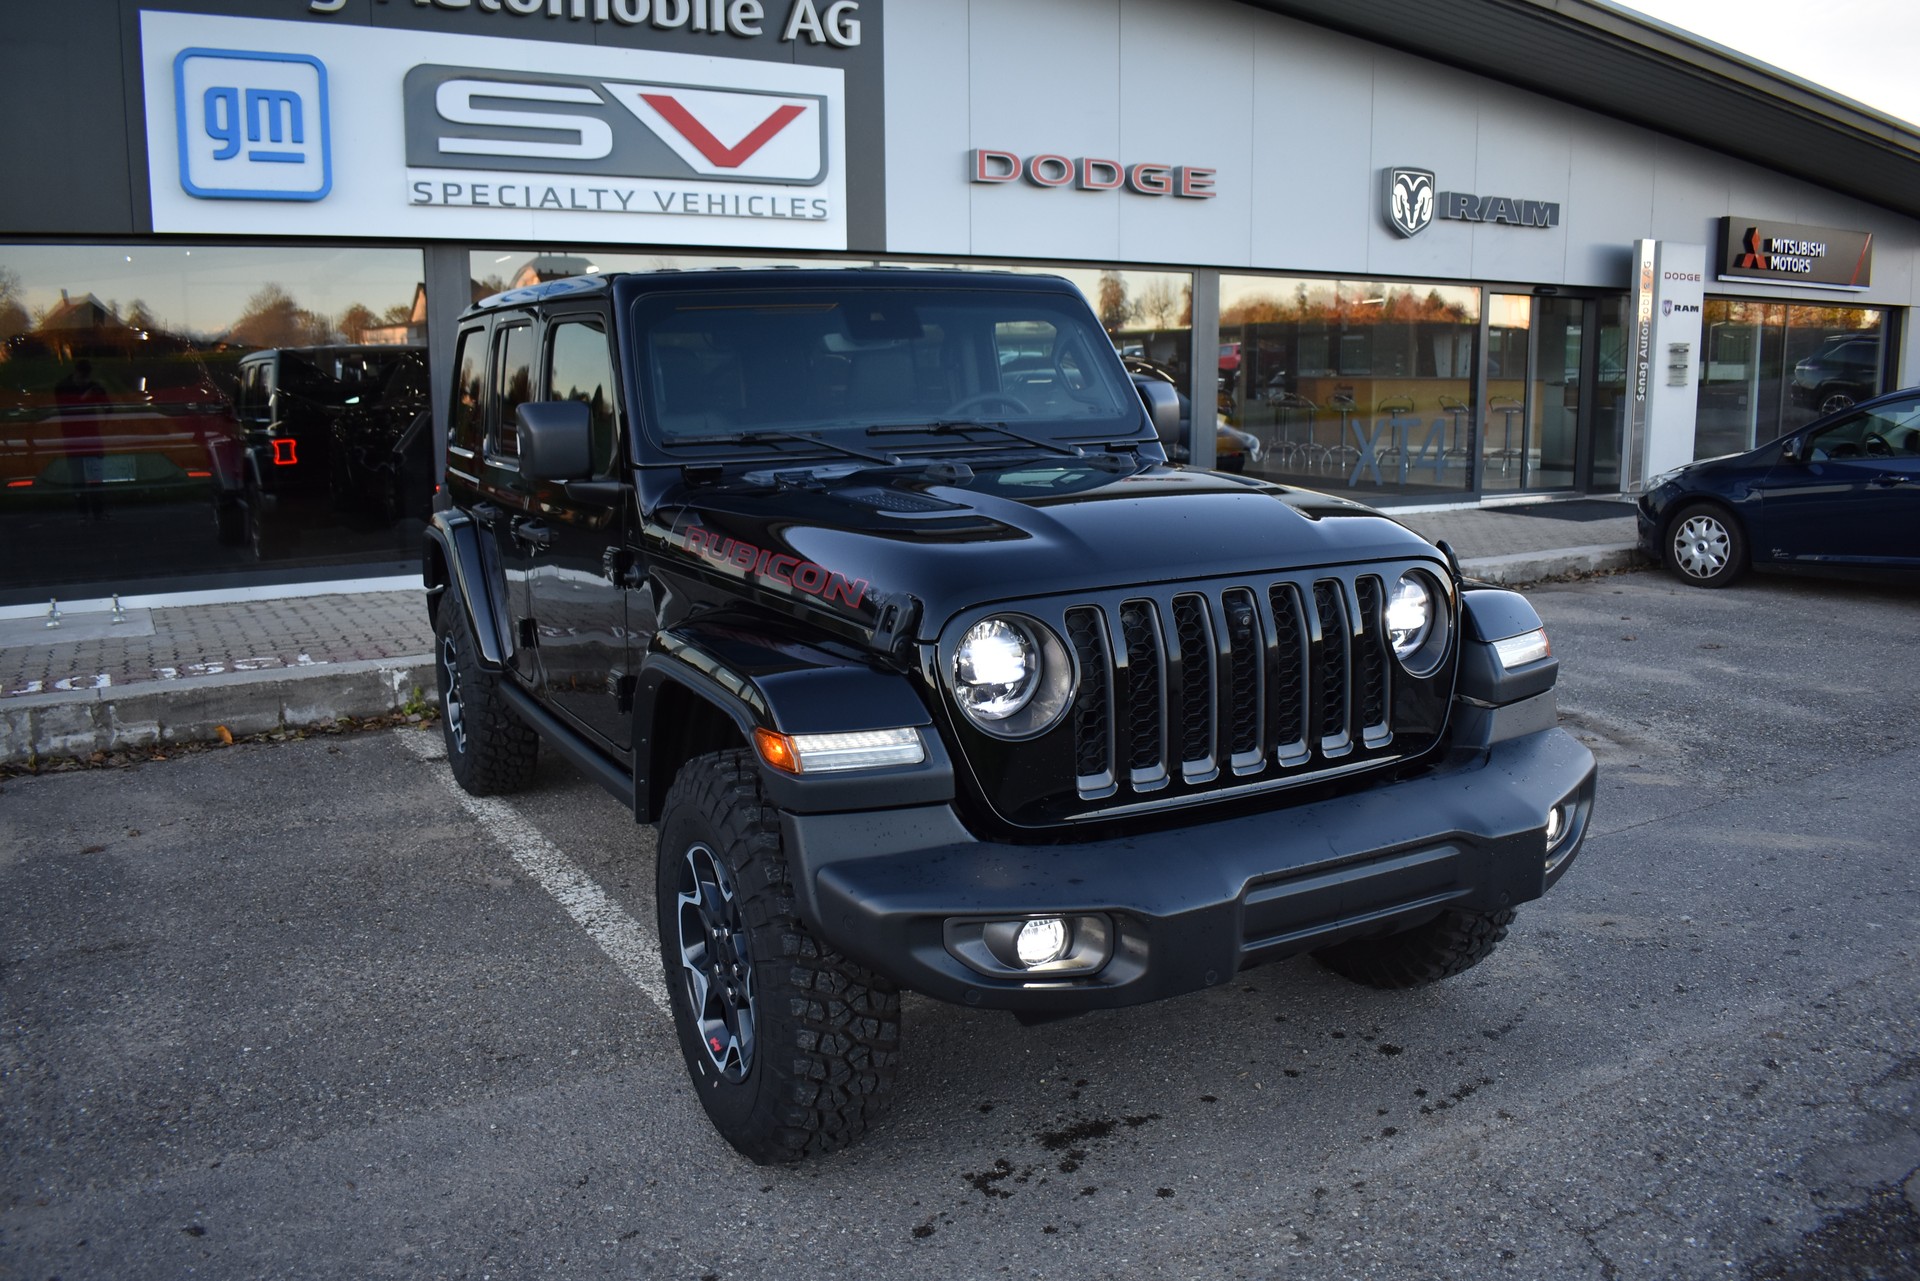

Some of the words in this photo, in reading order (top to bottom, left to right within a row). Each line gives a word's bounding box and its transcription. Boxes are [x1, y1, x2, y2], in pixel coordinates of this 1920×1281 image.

[782, 0, 863, 47] AG
[204, 86, 304, 162] gm
[970, 148, 1216, 199] DODGE
[412, 180, 634, 212] SPECIALTY
[654, 191, 829, 220] VEHICLES
[1439, 190, 1560, 228] RAM
[1770, 255, 1811, 273] MOTORS
[1771, 238, 1826, 257] MITSUBISHI
[1642, 260, 1651, 280] AG
[1664, 271, 1701, 282] DODGE
[1674, 304, 1700, 313] RAM
[1636, 362, 1649, 401] Senag
[1348, 417, 1447, 487] XT4
[682, 525, 869, 609] RUBICON
